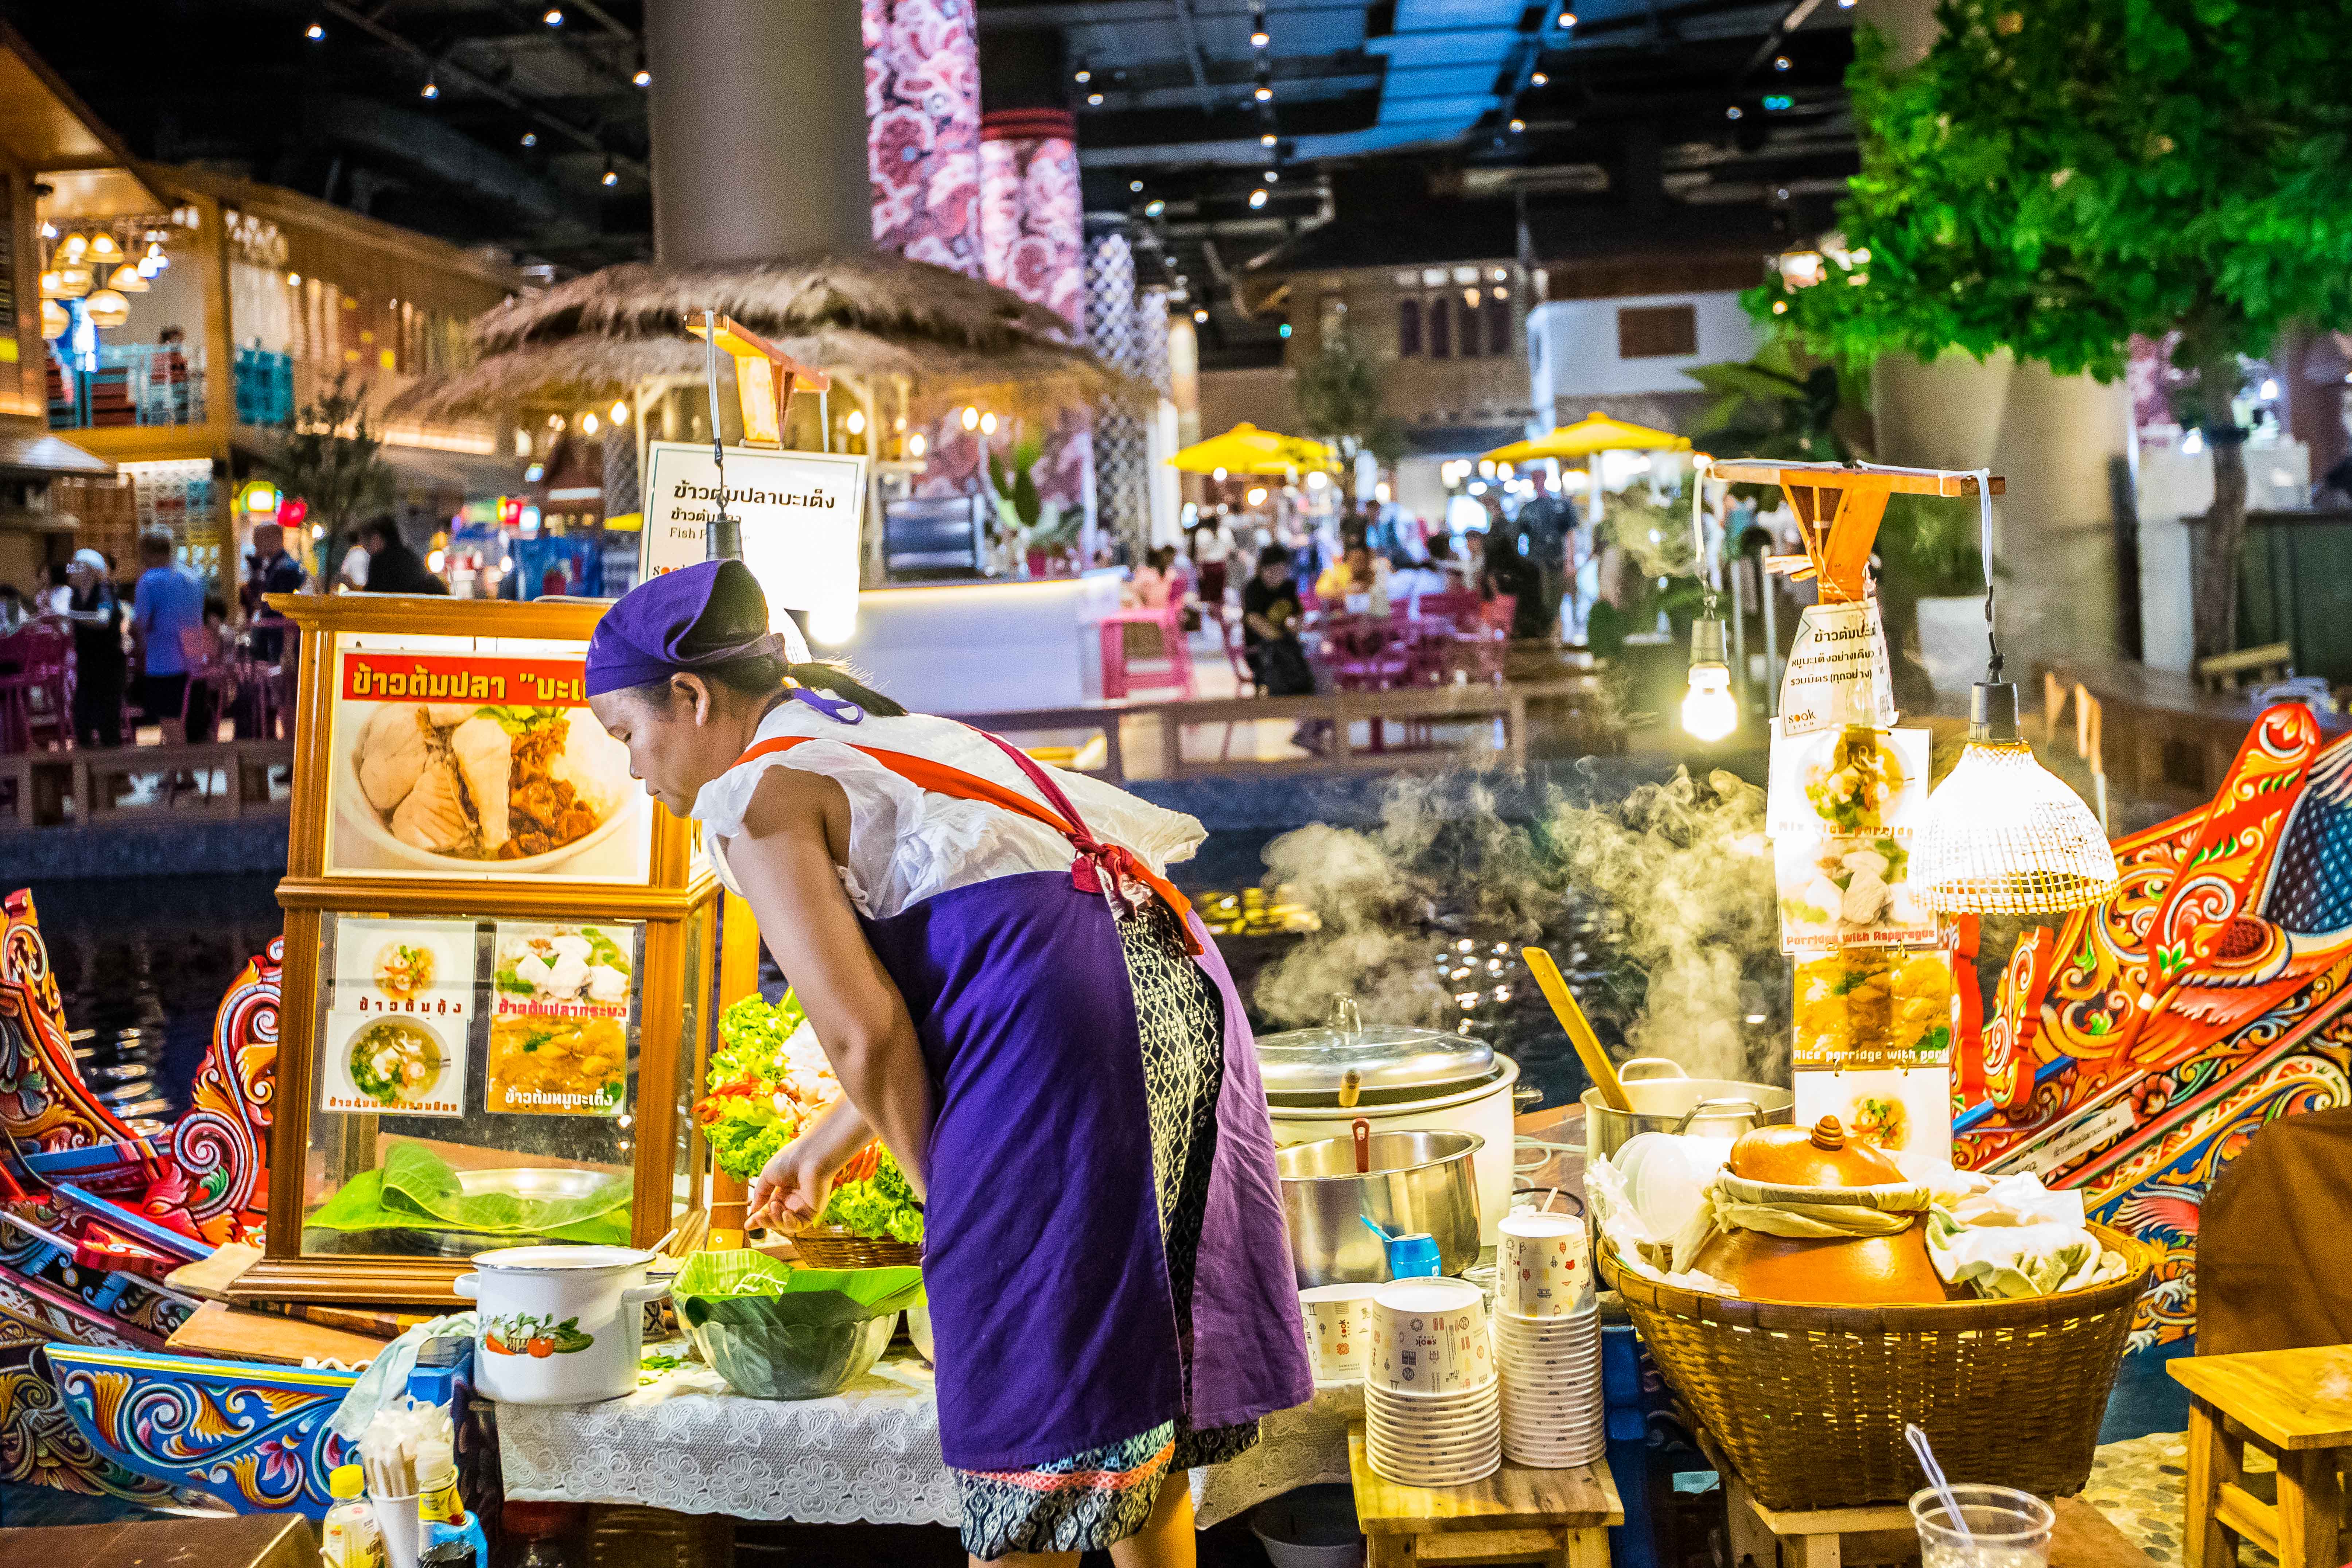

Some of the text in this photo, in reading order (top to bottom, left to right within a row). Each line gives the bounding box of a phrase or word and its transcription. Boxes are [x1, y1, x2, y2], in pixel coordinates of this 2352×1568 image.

[670, 527, 695, 539] Fish
[353, 662, 589, 702] ข้าวต้มปลา "บะเ
[1788, 709, 1816, 724] sook
[1813, 824, 1846, 834] ice
[359, 996, 461, 1015] ข้าวต้มกุ้ง
[1793, 1049, 1821, 1060] Rice
[1826, 1050, 1882, 1062] porridge
[1887, 1049, 1916, 1060] with
[505, 1085, 613, 1110] ข้าวต้มหมูบะเต็ง
[1338, 1319, 1347, 1338] sook
